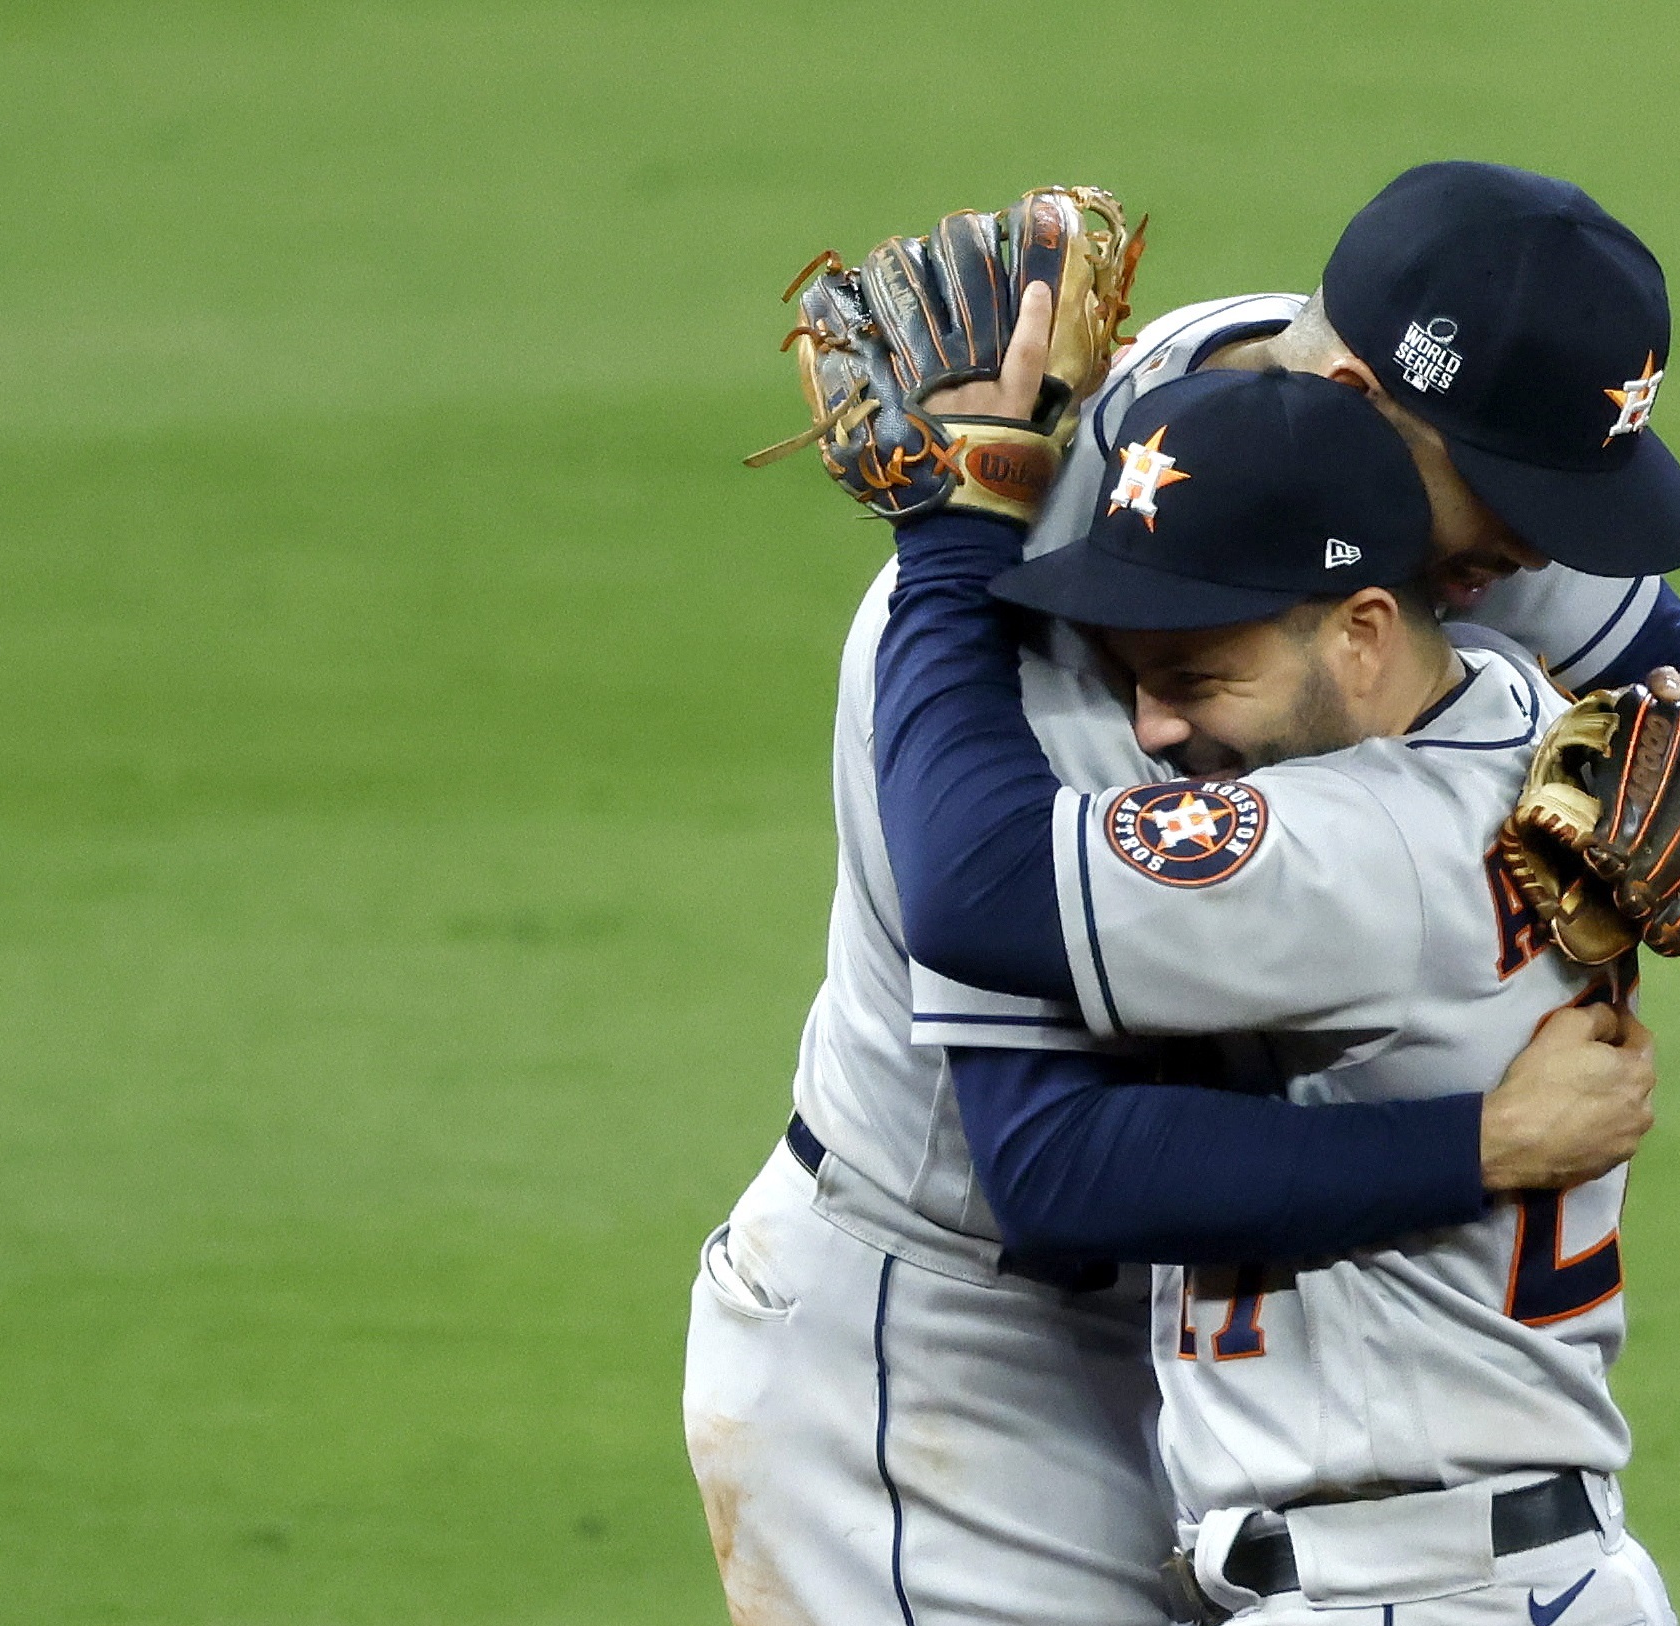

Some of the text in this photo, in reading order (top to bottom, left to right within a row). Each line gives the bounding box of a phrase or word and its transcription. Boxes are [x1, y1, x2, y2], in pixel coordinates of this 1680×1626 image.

[1395, 342, 1454, 390] SERIES
[1404, 325, 1461, 375] WORLD
[1115, 797, 1166, 871] ASTROS
[1201, 782, 1259, 856] HOUSTON
